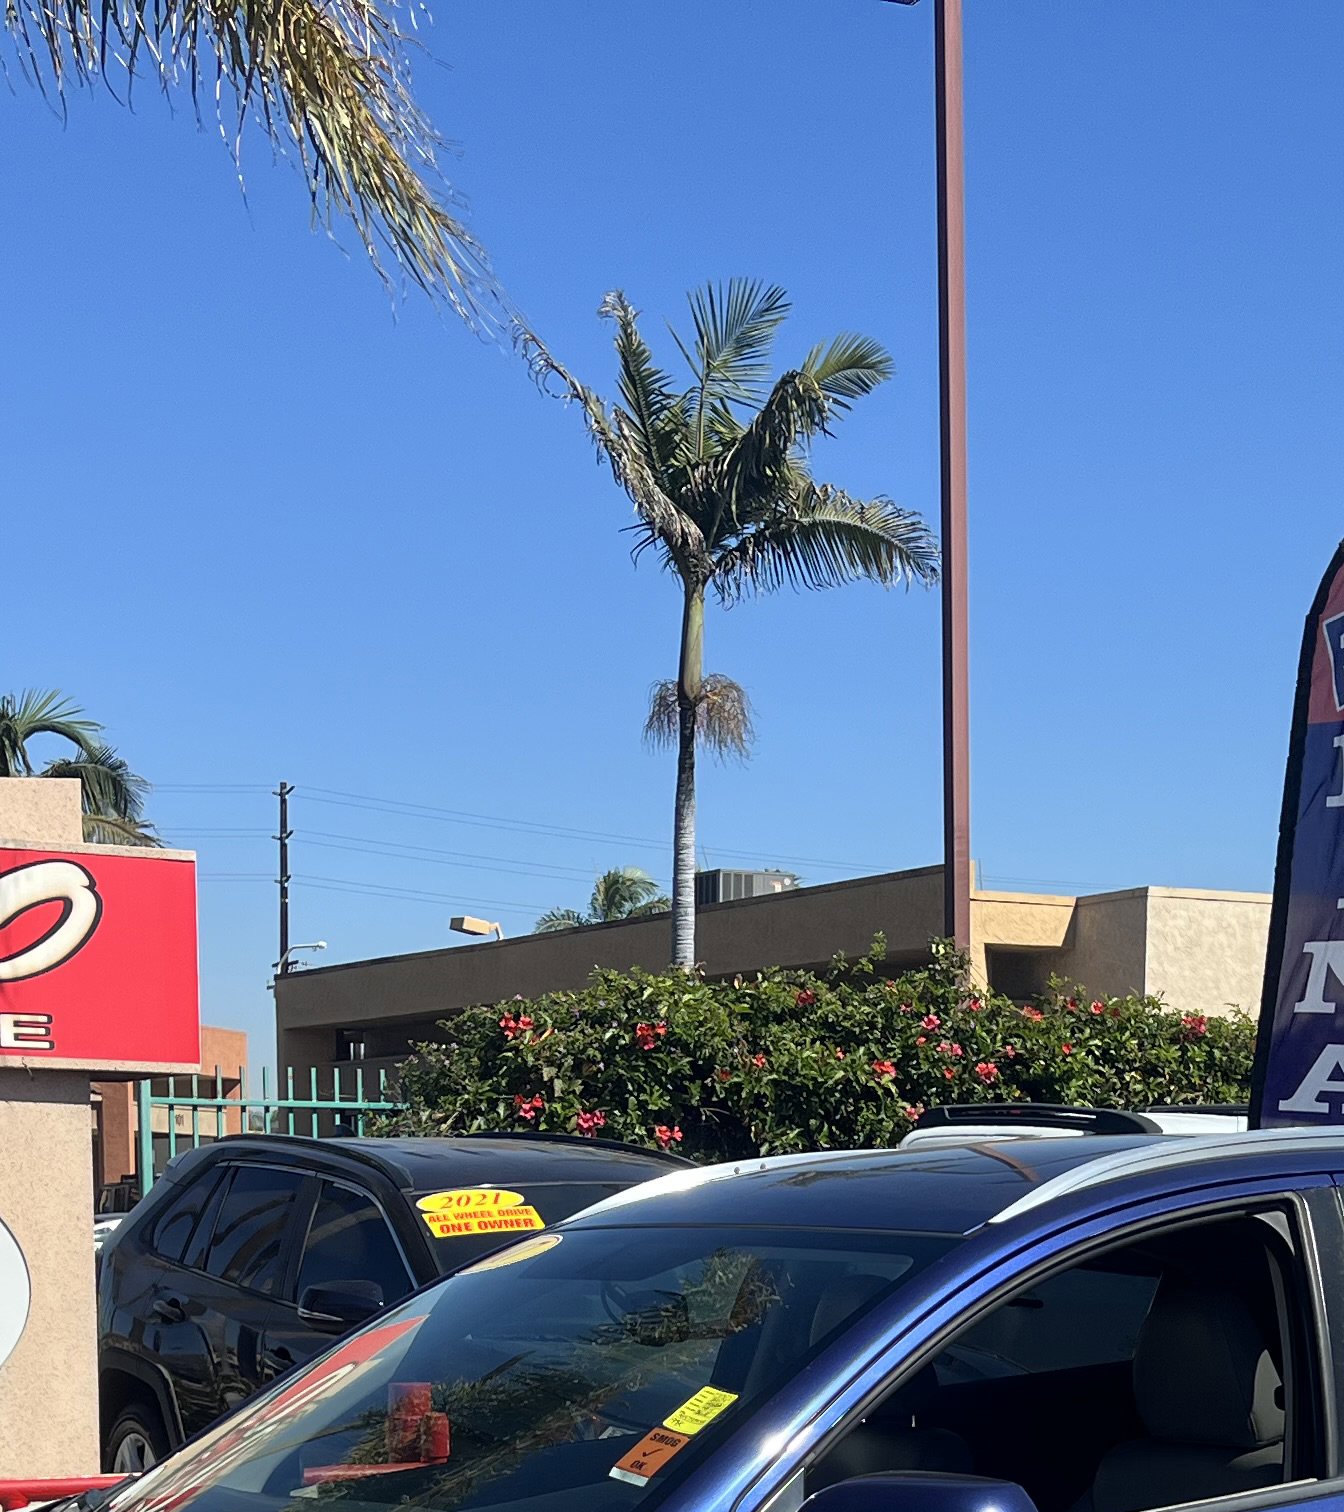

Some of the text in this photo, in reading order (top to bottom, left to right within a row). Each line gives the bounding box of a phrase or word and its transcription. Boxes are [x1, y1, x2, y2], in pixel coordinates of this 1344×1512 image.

[440, 1192, 501, 1209] 2021
[428, 1208, 532, 1223] ALL WHEEL DRIVE
[439, 1218, 535, 1235] ONE OWNER
[650, 1432, 682, 1448] SMOG
[629, 1460, 648, 1471] OK
